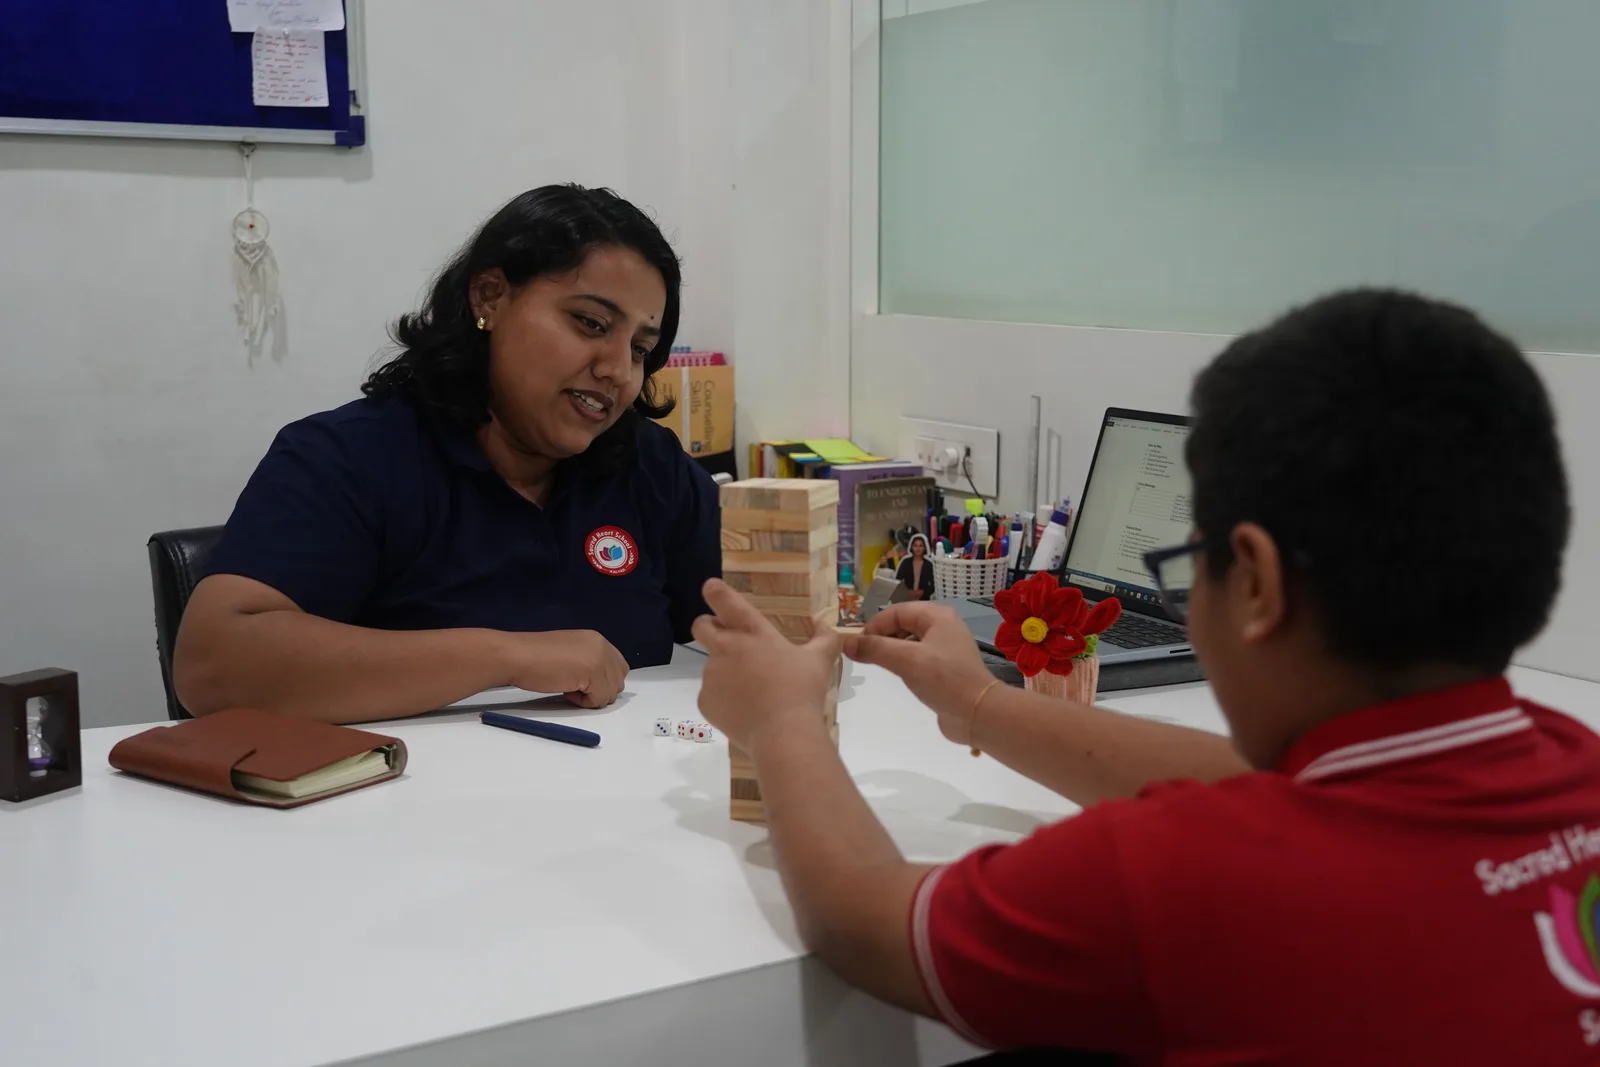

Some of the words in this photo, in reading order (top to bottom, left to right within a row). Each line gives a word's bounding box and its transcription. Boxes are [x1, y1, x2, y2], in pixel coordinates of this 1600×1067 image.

[690, 380, 702, 414] Skills
[880, 485, 934, 497] UNDERSTAN
[588, 535, 597, 555] Sacred
[615, 532, 632, 549] School
[1474, 831, 1571, 896] Sacred
